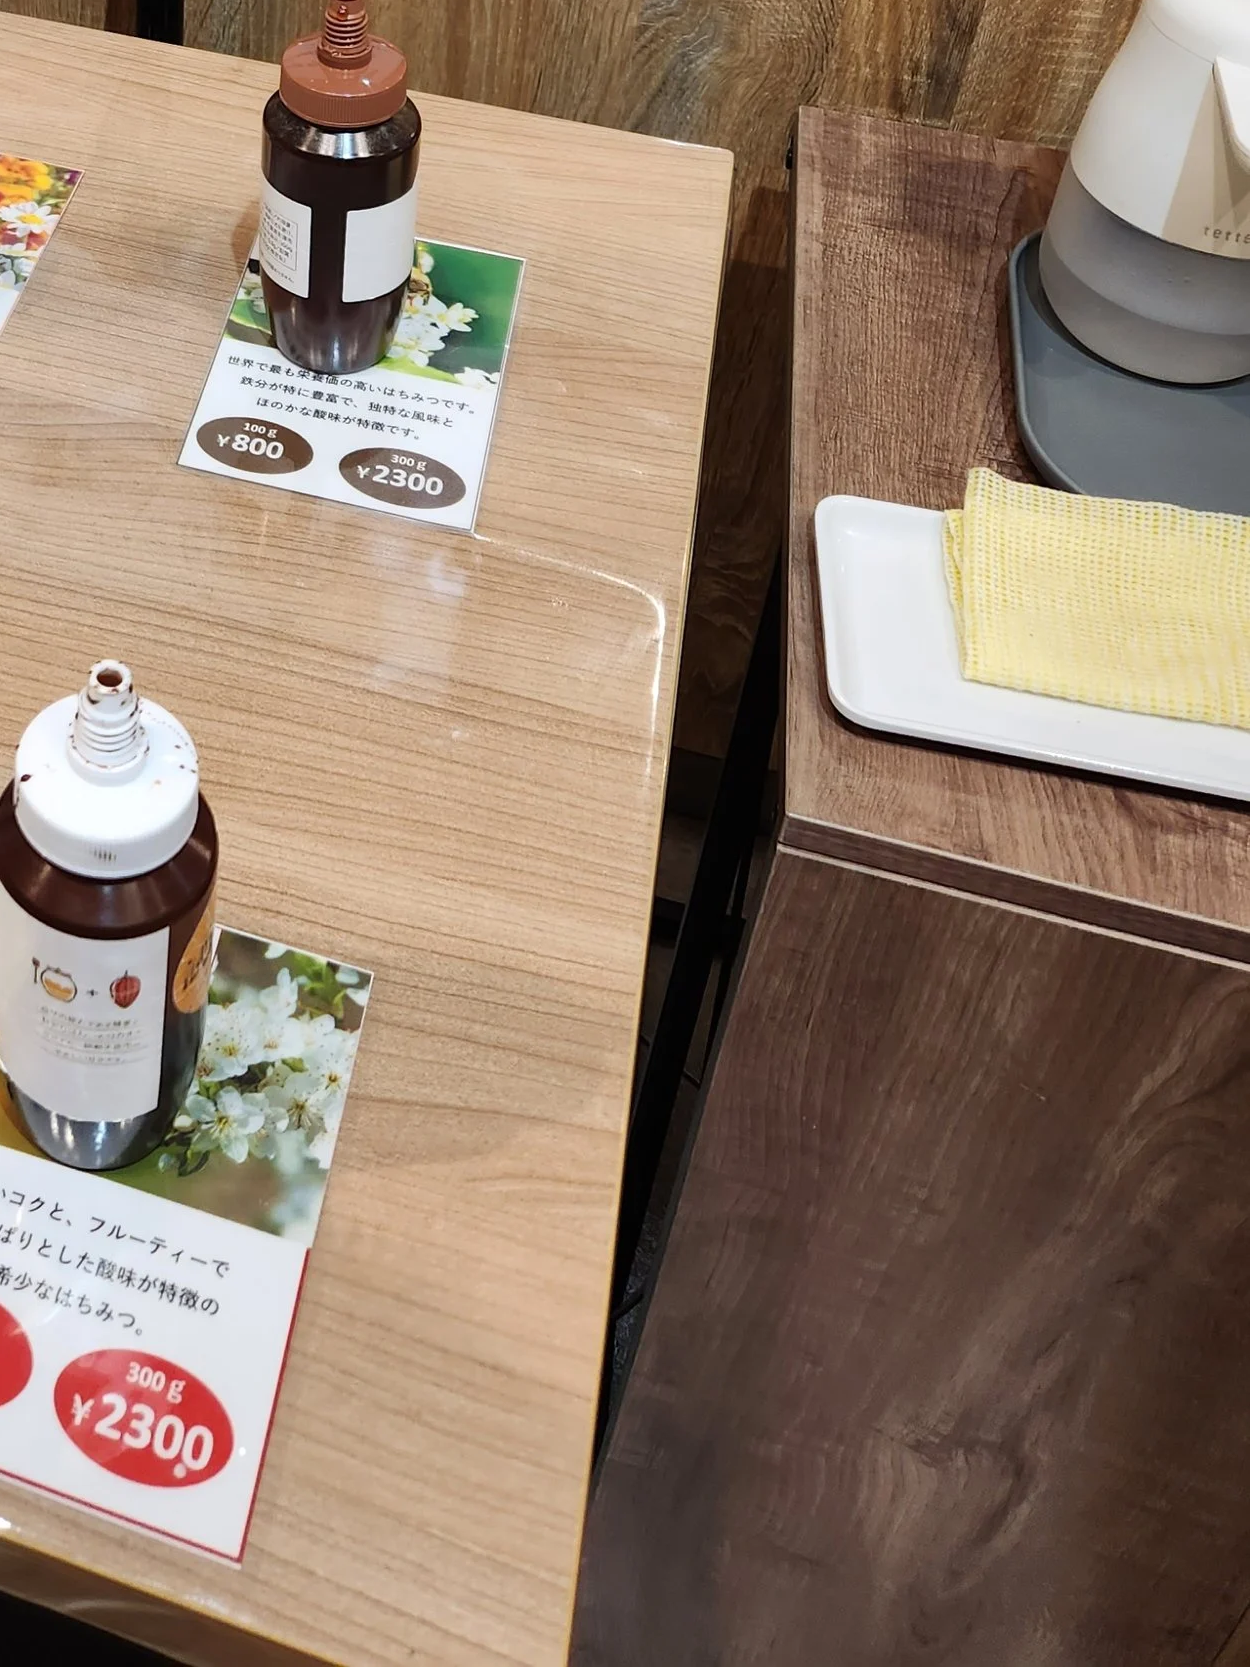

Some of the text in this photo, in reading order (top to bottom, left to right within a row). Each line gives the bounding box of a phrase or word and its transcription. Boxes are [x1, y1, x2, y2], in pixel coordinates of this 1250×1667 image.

[255, 397, 421, 441] ほのかな酸味が特徴です。
[216, 432, 445, 497] ¥800 ¥2300
[69, 1392, 216, 1472] ¥2300
